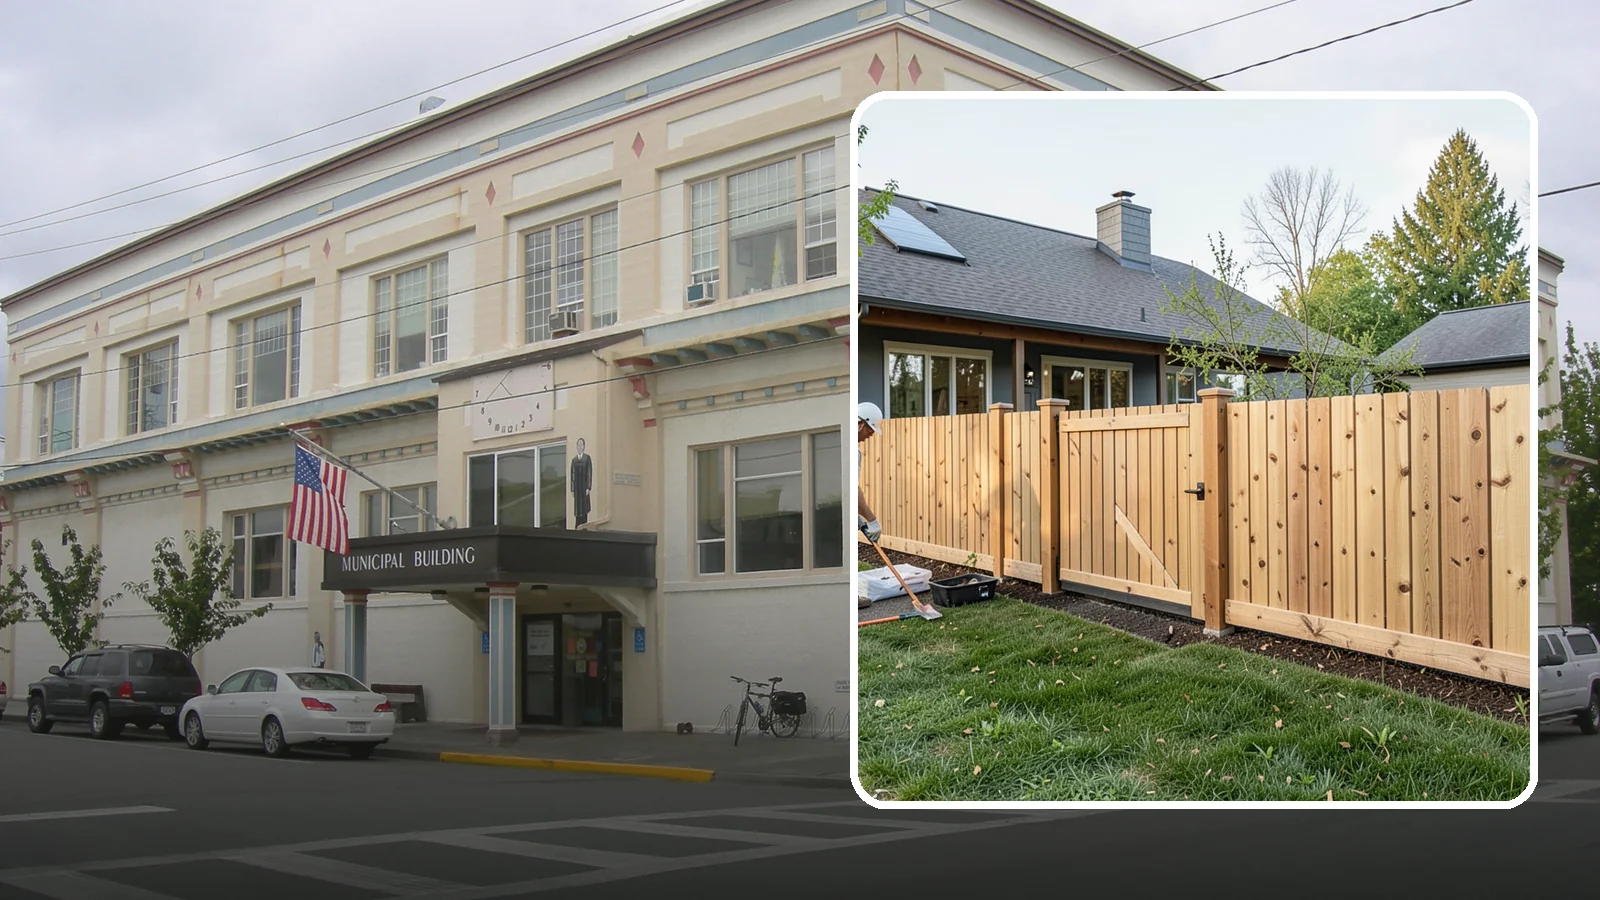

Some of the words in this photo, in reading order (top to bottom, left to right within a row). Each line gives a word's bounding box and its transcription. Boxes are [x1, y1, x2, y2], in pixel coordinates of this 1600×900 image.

[507, 425, 513, 433] 12
[342, 552, 405, 572] MUNICIPAL
[414, 546, 476, 567] BUILDING
